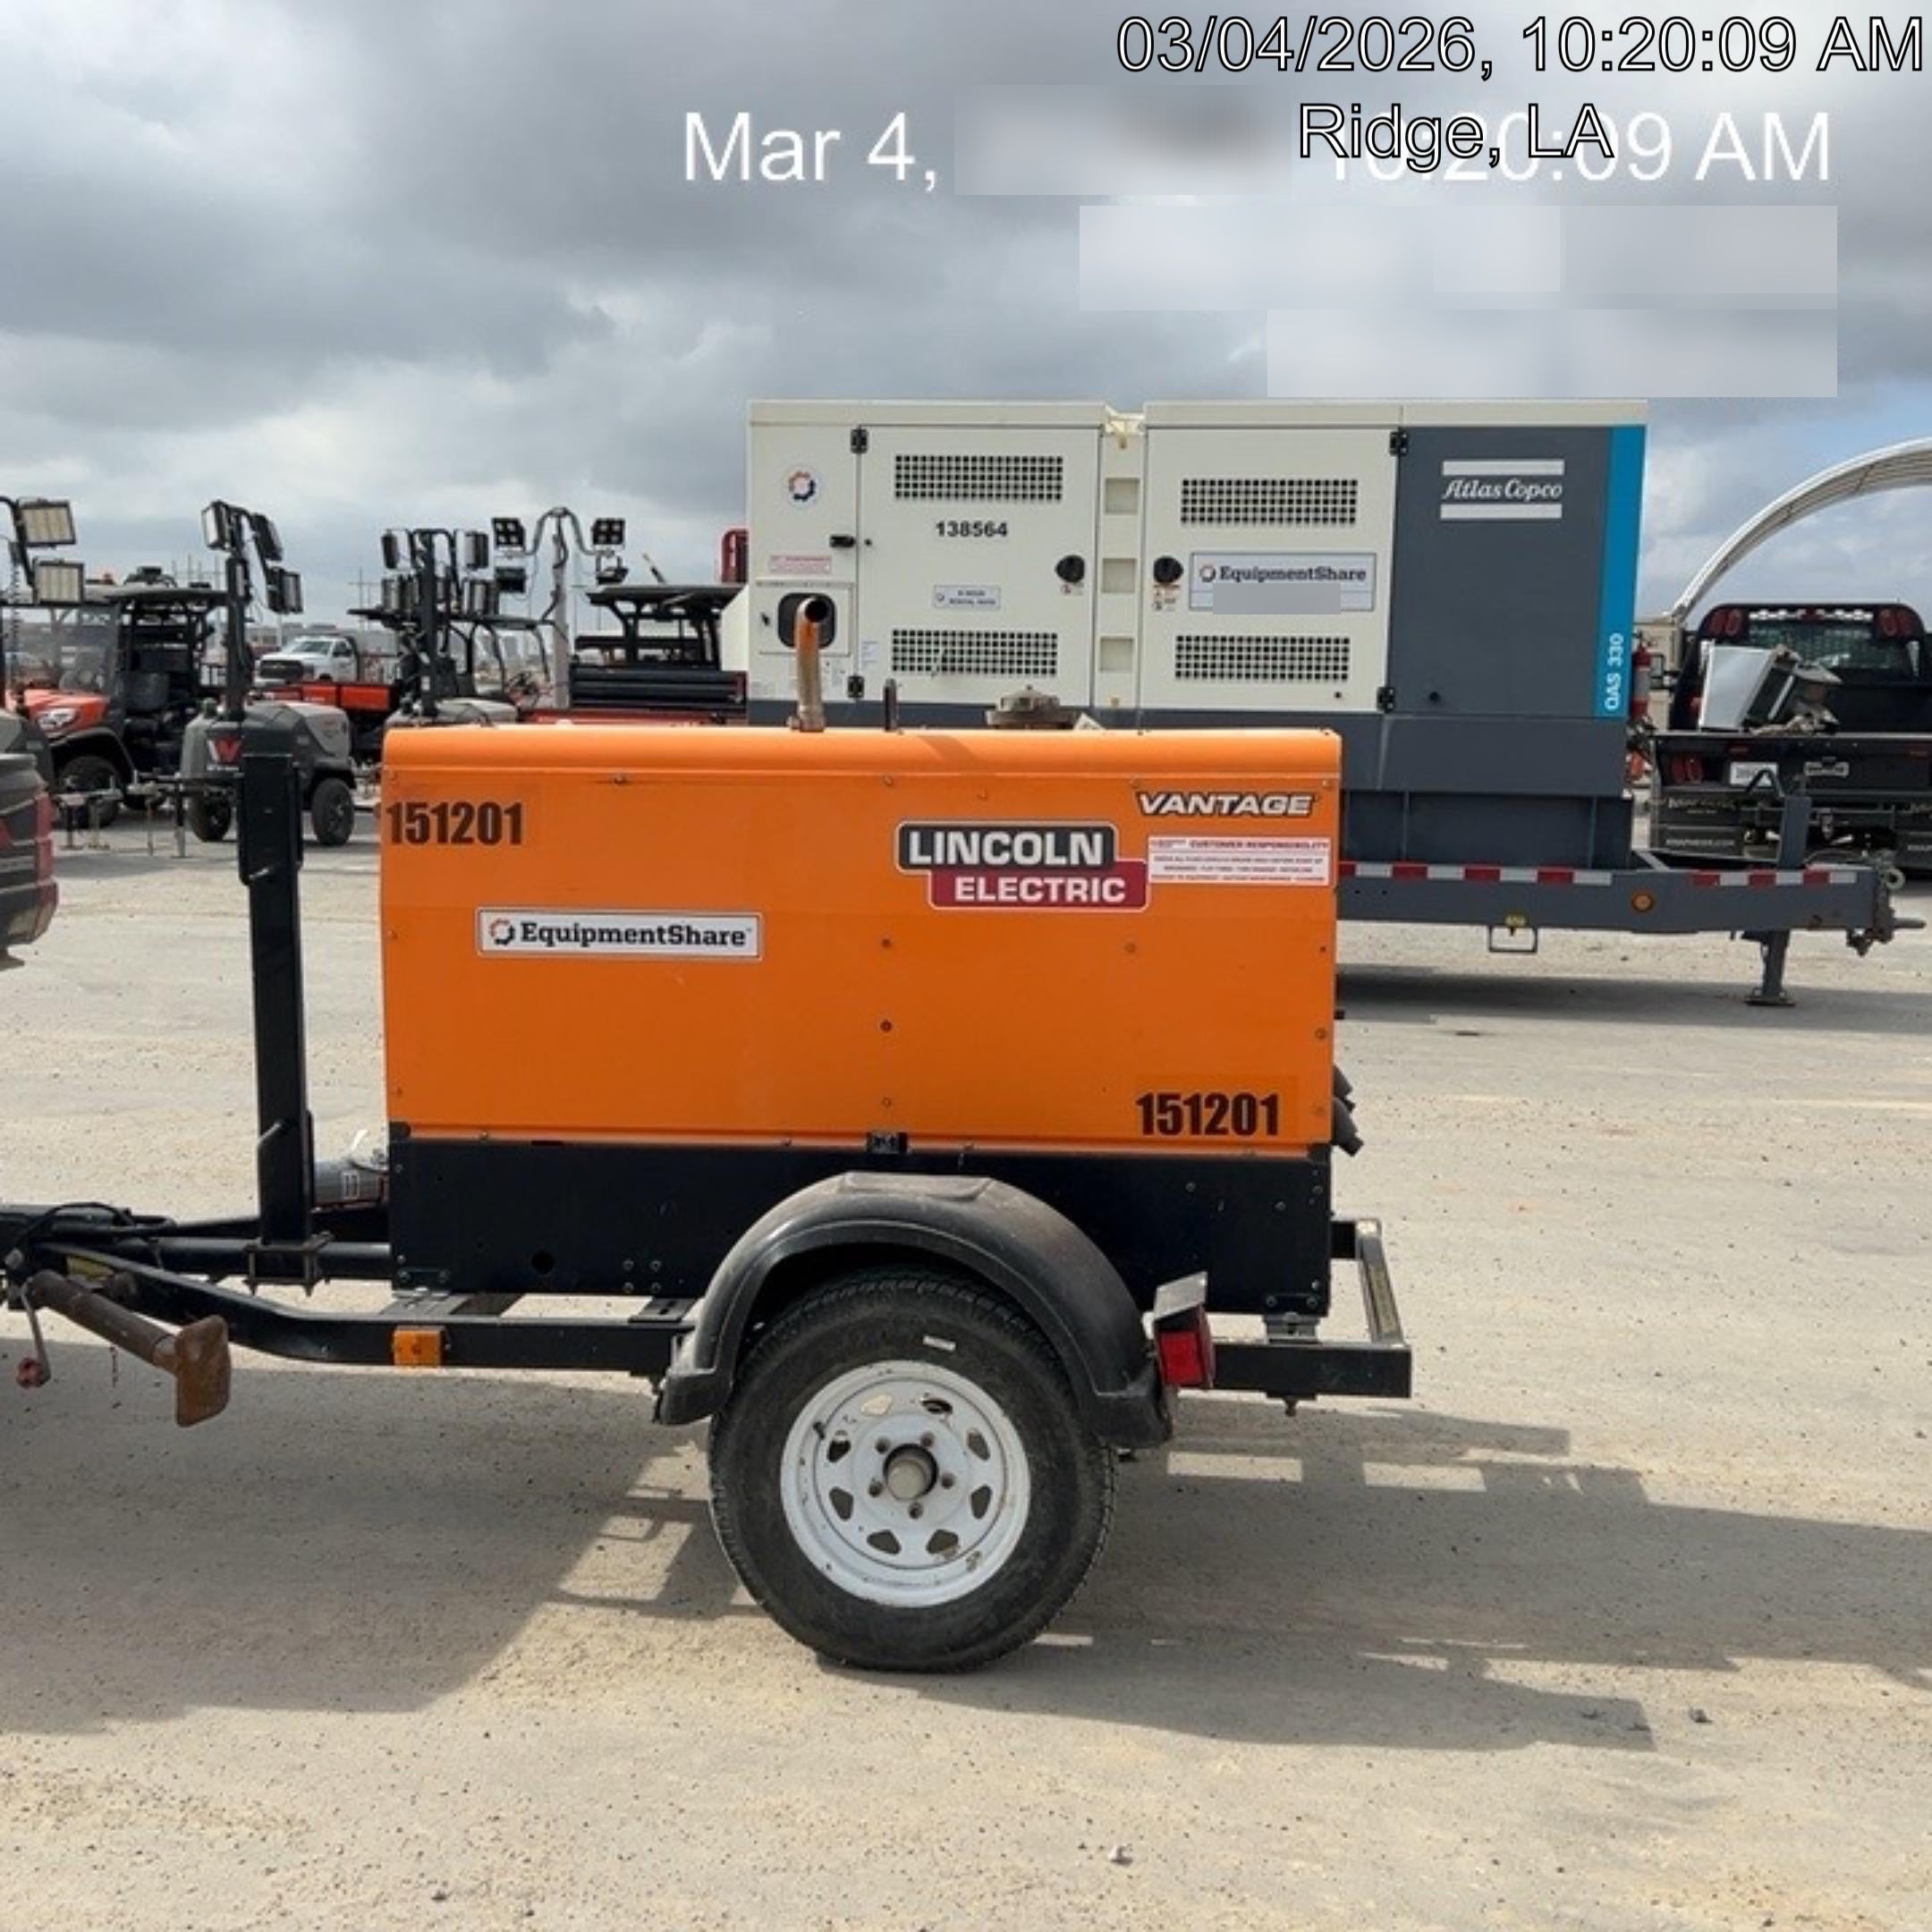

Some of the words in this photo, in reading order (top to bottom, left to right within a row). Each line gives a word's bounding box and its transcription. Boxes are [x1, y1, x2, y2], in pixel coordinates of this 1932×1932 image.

[1442, 479, 1503, 499] Atlas
[1504, 479, 1563, 502] Copco
[936, 521, 1009, 538] 138564
[1219, 565, 1368, 583] EquipmentShare
[1140, 793, 1315, 816] VANTAGE
[386, 801, 522, 845] 151201
[908, 831, 1104, 866] LINCOLN
[954, 876, 1126, 903] ELECTRIC
[521, 922, 747, 948] EquipmentShare
[1136, 1092, 1279, 1136] 151201
